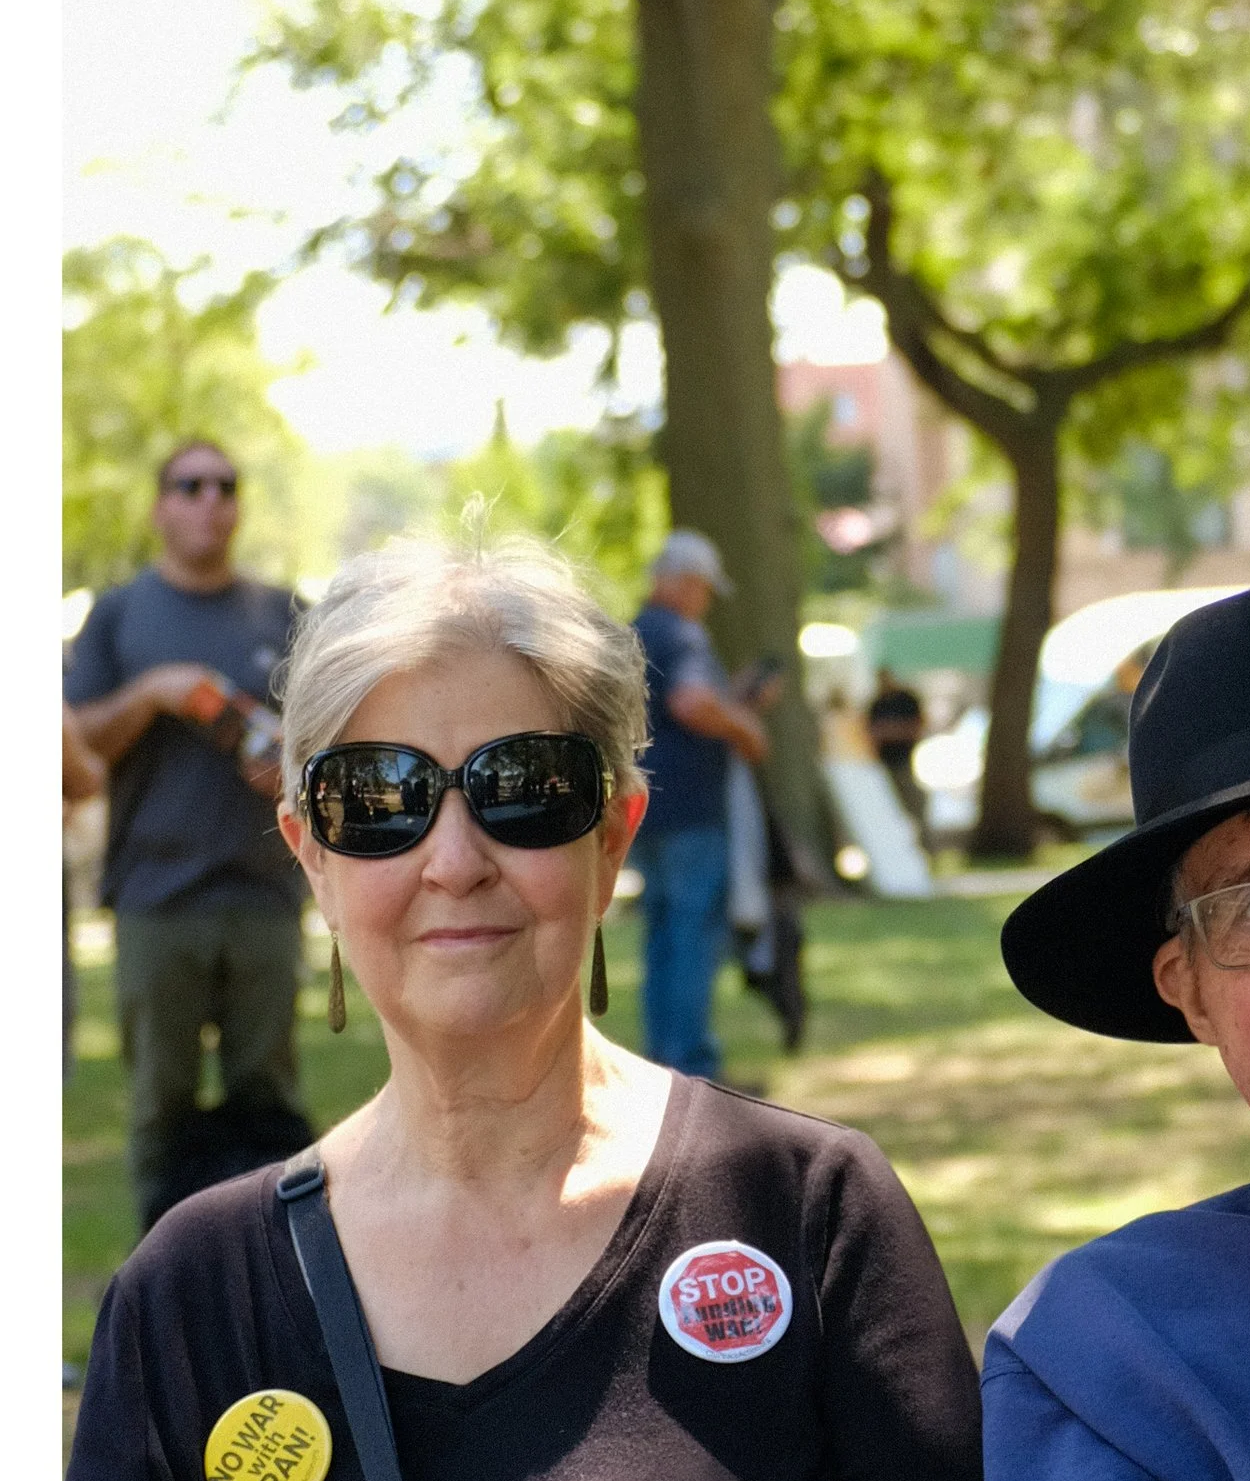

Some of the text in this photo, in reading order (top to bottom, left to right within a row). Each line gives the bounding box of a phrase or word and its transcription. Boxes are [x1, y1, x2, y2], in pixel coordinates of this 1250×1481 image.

[678, 1267, 766, 1303] STOP
[231, 1394, 284, 1451] WAR
[248, 1431, 286, 1476] with
